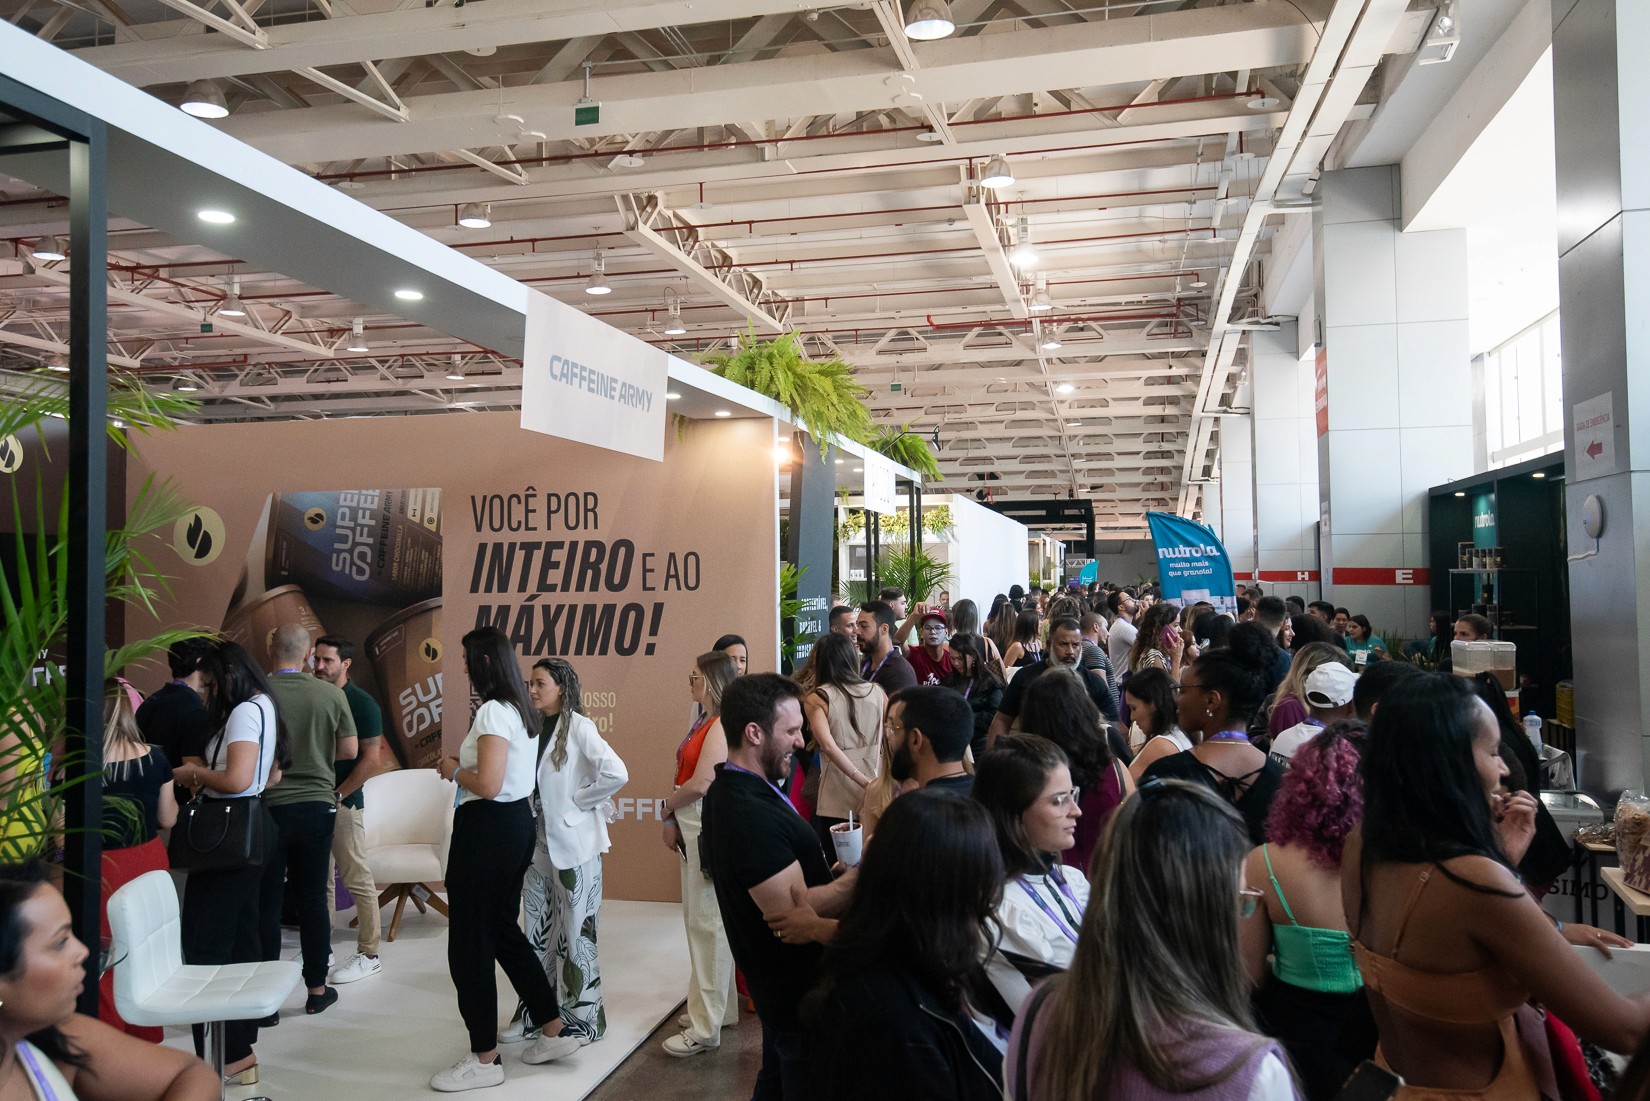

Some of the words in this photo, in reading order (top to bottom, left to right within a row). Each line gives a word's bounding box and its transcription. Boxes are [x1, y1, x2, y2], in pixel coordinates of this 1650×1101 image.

[549, 355, 618, 400] CAFFEINE
[618, 381, 653, 412] ARMY
[470, 485, 538, 532] VOCÊ
[546, 491, 599, 531] POR
[331, 490, 359, 575] SUPE
[469, 538, 635, 593] INTEIRO
[641, 552, 656, 591] E
[663, 551, 700, 591] AO
[1158, 544, 1220, 558] nutrola
[1191, 560, 1209, 568] mais
[1297, 571, 1309, 581] H
[1395, 569, 1414, 584] E
